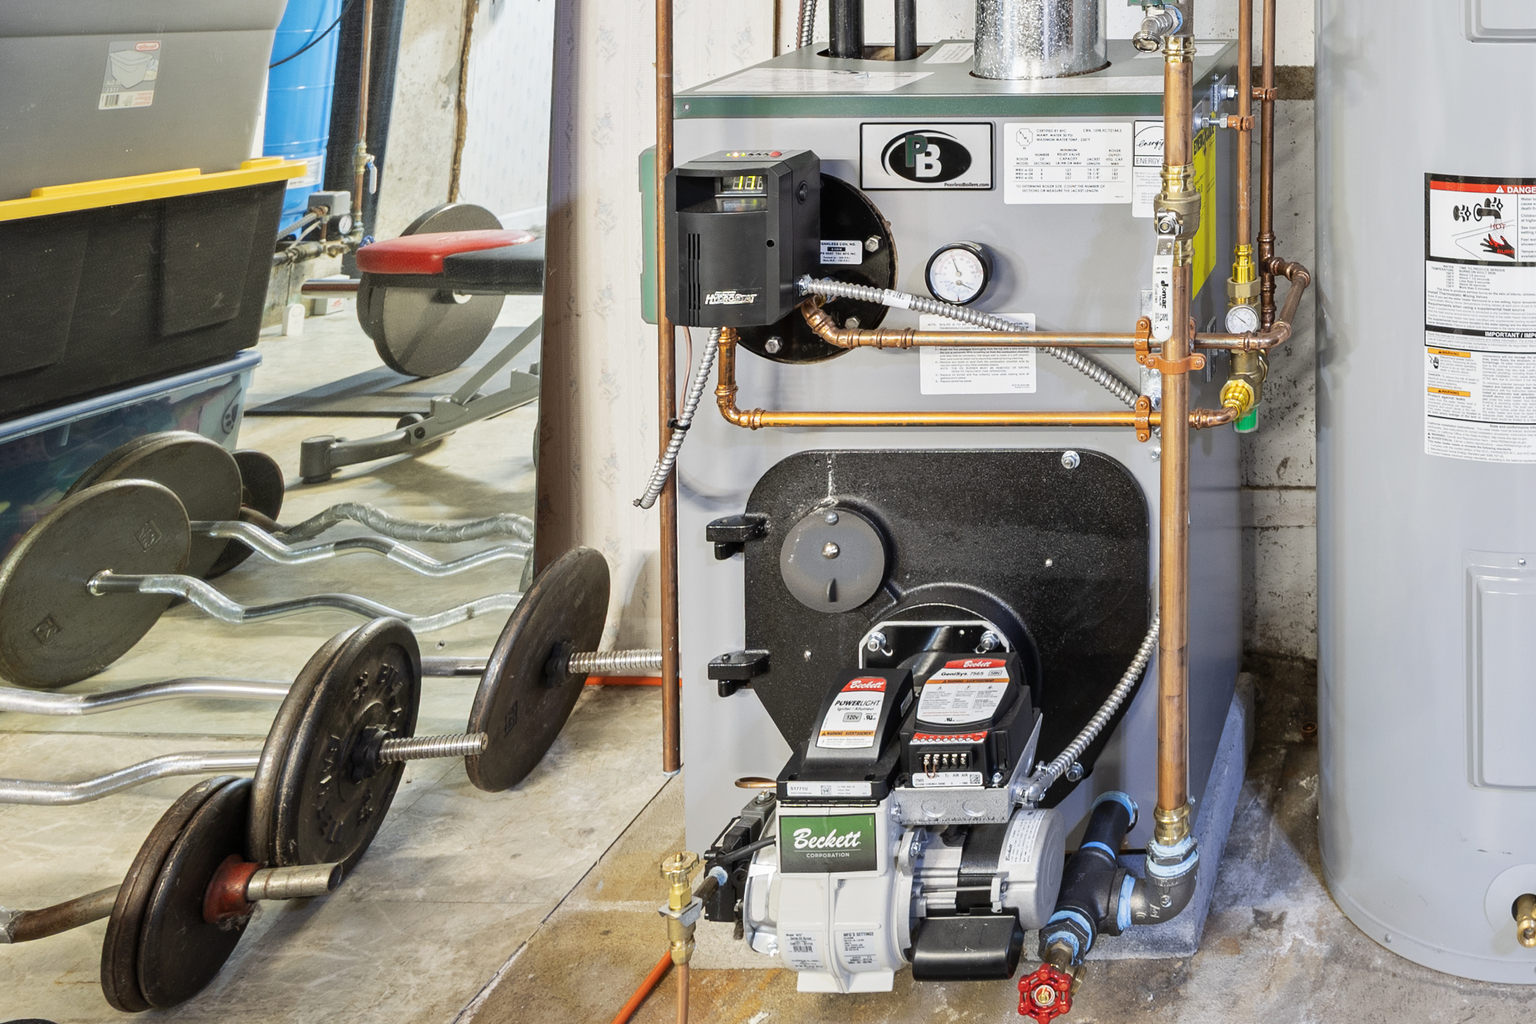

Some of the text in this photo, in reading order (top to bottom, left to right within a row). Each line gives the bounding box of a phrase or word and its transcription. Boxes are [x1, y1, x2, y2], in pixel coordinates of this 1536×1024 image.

[963, 660, 992, 668] Beckett
[850, 680, 884, 689] Beckett
[793, 827, 861, 850] Beckett
